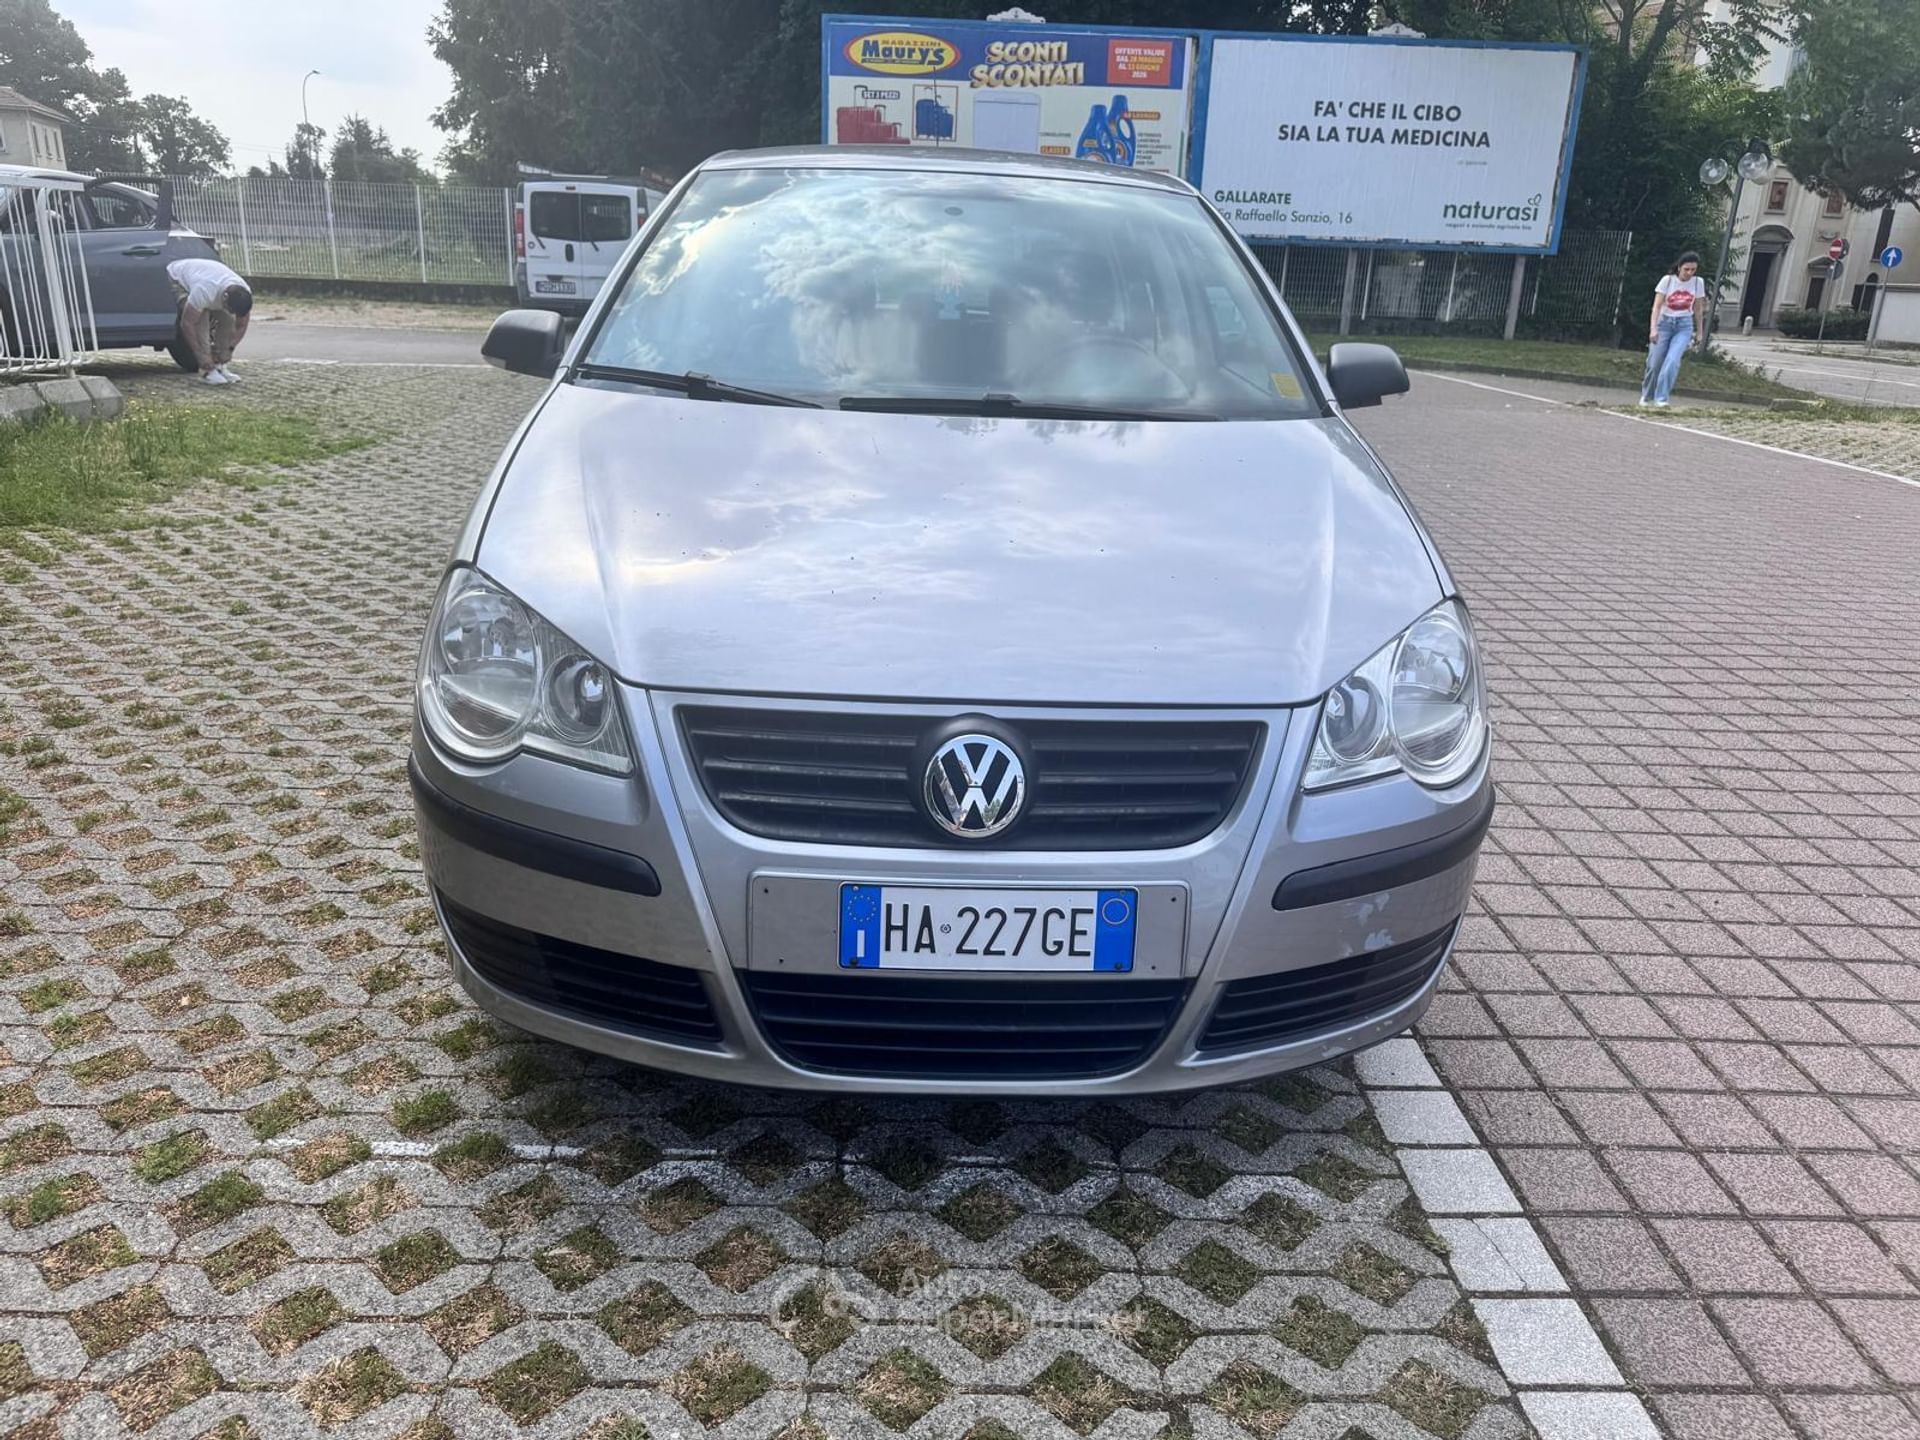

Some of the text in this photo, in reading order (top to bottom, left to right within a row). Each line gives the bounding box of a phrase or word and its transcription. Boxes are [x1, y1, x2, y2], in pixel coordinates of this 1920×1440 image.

[861, 40, 945, 66] Maury's
[985, 41, 1068, 63] SCONTI
[1115, 48, 1142, 56] OFFERTE
[969, 62, 1084, 88] SCONTATI
[1313, 100, 1462, 122] FA' CHE IL CIBO
[1278, 124, 1491, 148] SIA LA TUA MEDICINA
[1214, 190, 1292, 205] GALLARATE
[1235, 208, 1287, 222] Raffaello
[1291, 210, 1333, 225] Sanzio,
[1338, 211, 1353, 224] 16
[884, 903, 1095, 957] HA 227GE
